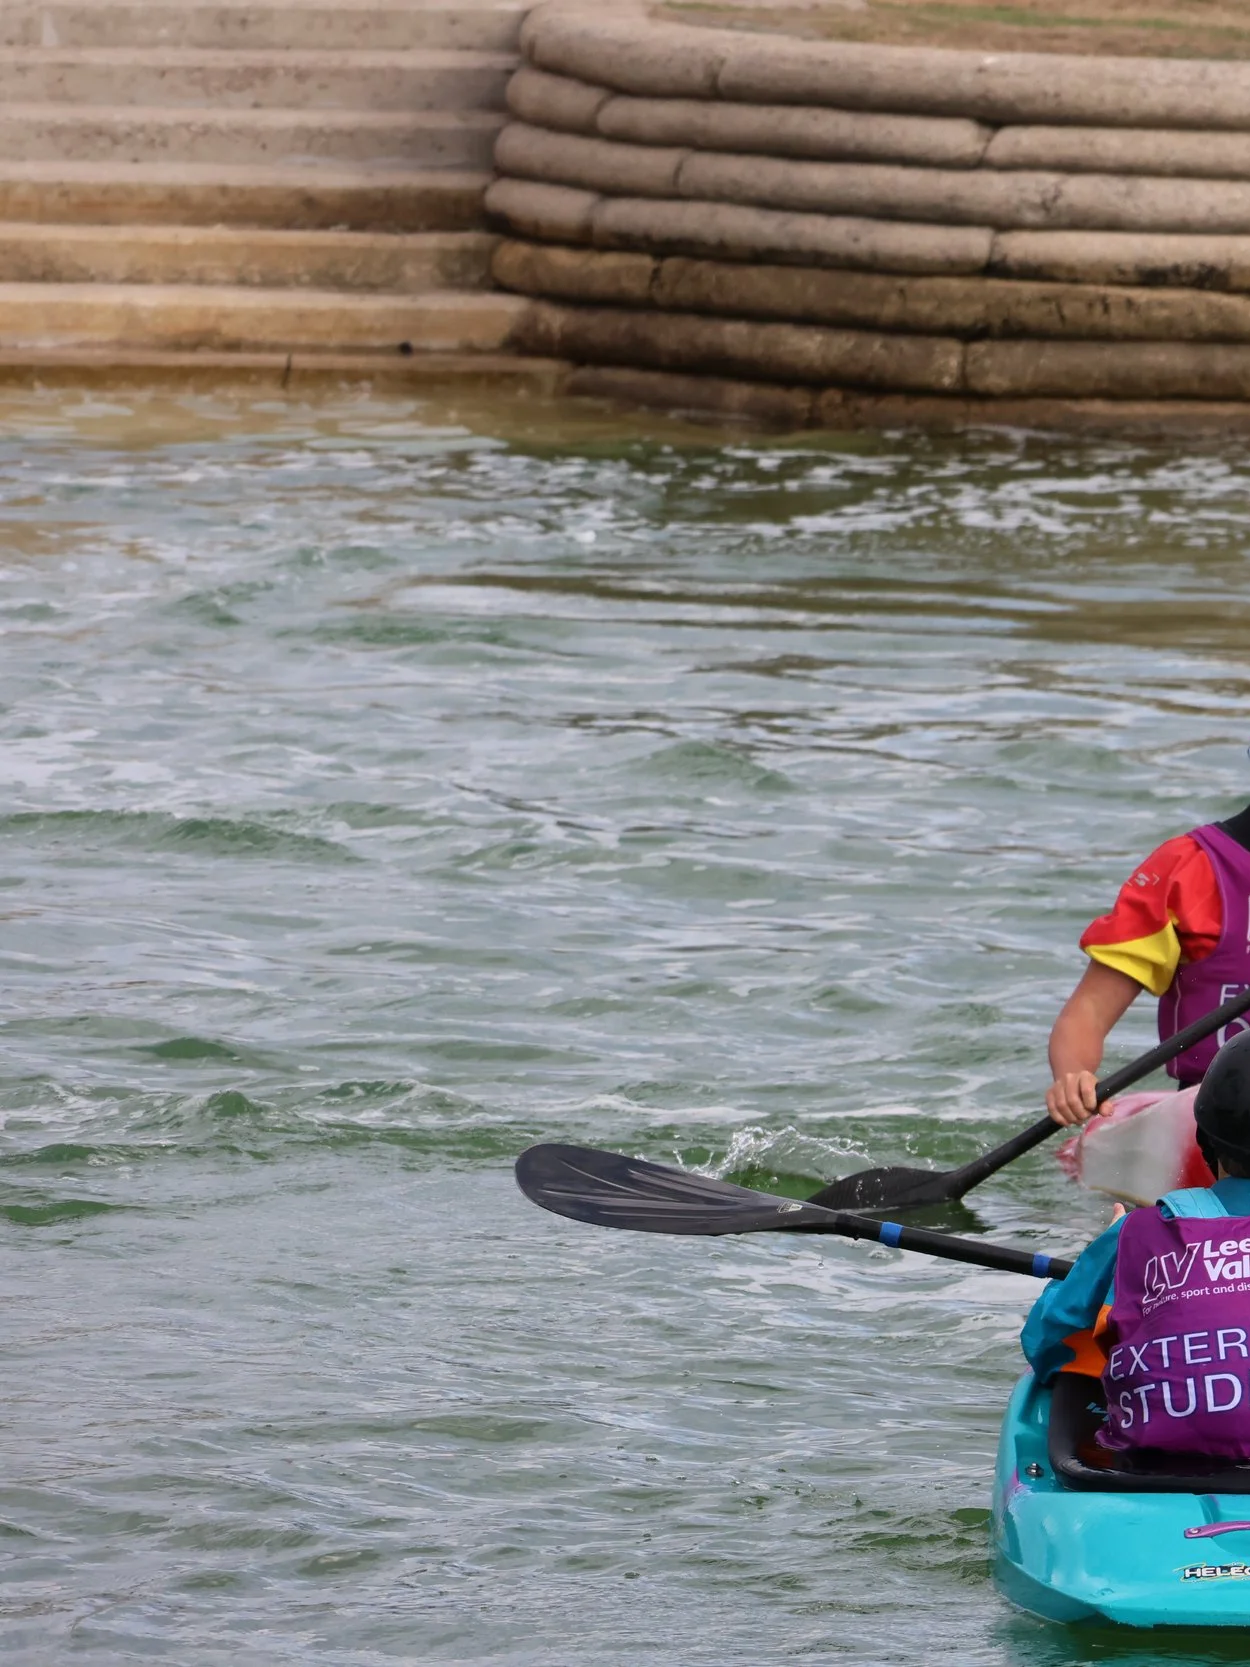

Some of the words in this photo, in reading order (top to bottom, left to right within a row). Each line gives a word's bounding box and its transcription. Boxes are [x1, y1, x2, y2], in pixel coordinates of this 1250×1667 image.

[1142, 1242, 1201, 1304] LV
[1181, 1286, 1210, 1300] sport
[1213, 1281, 1235, 1294] and
